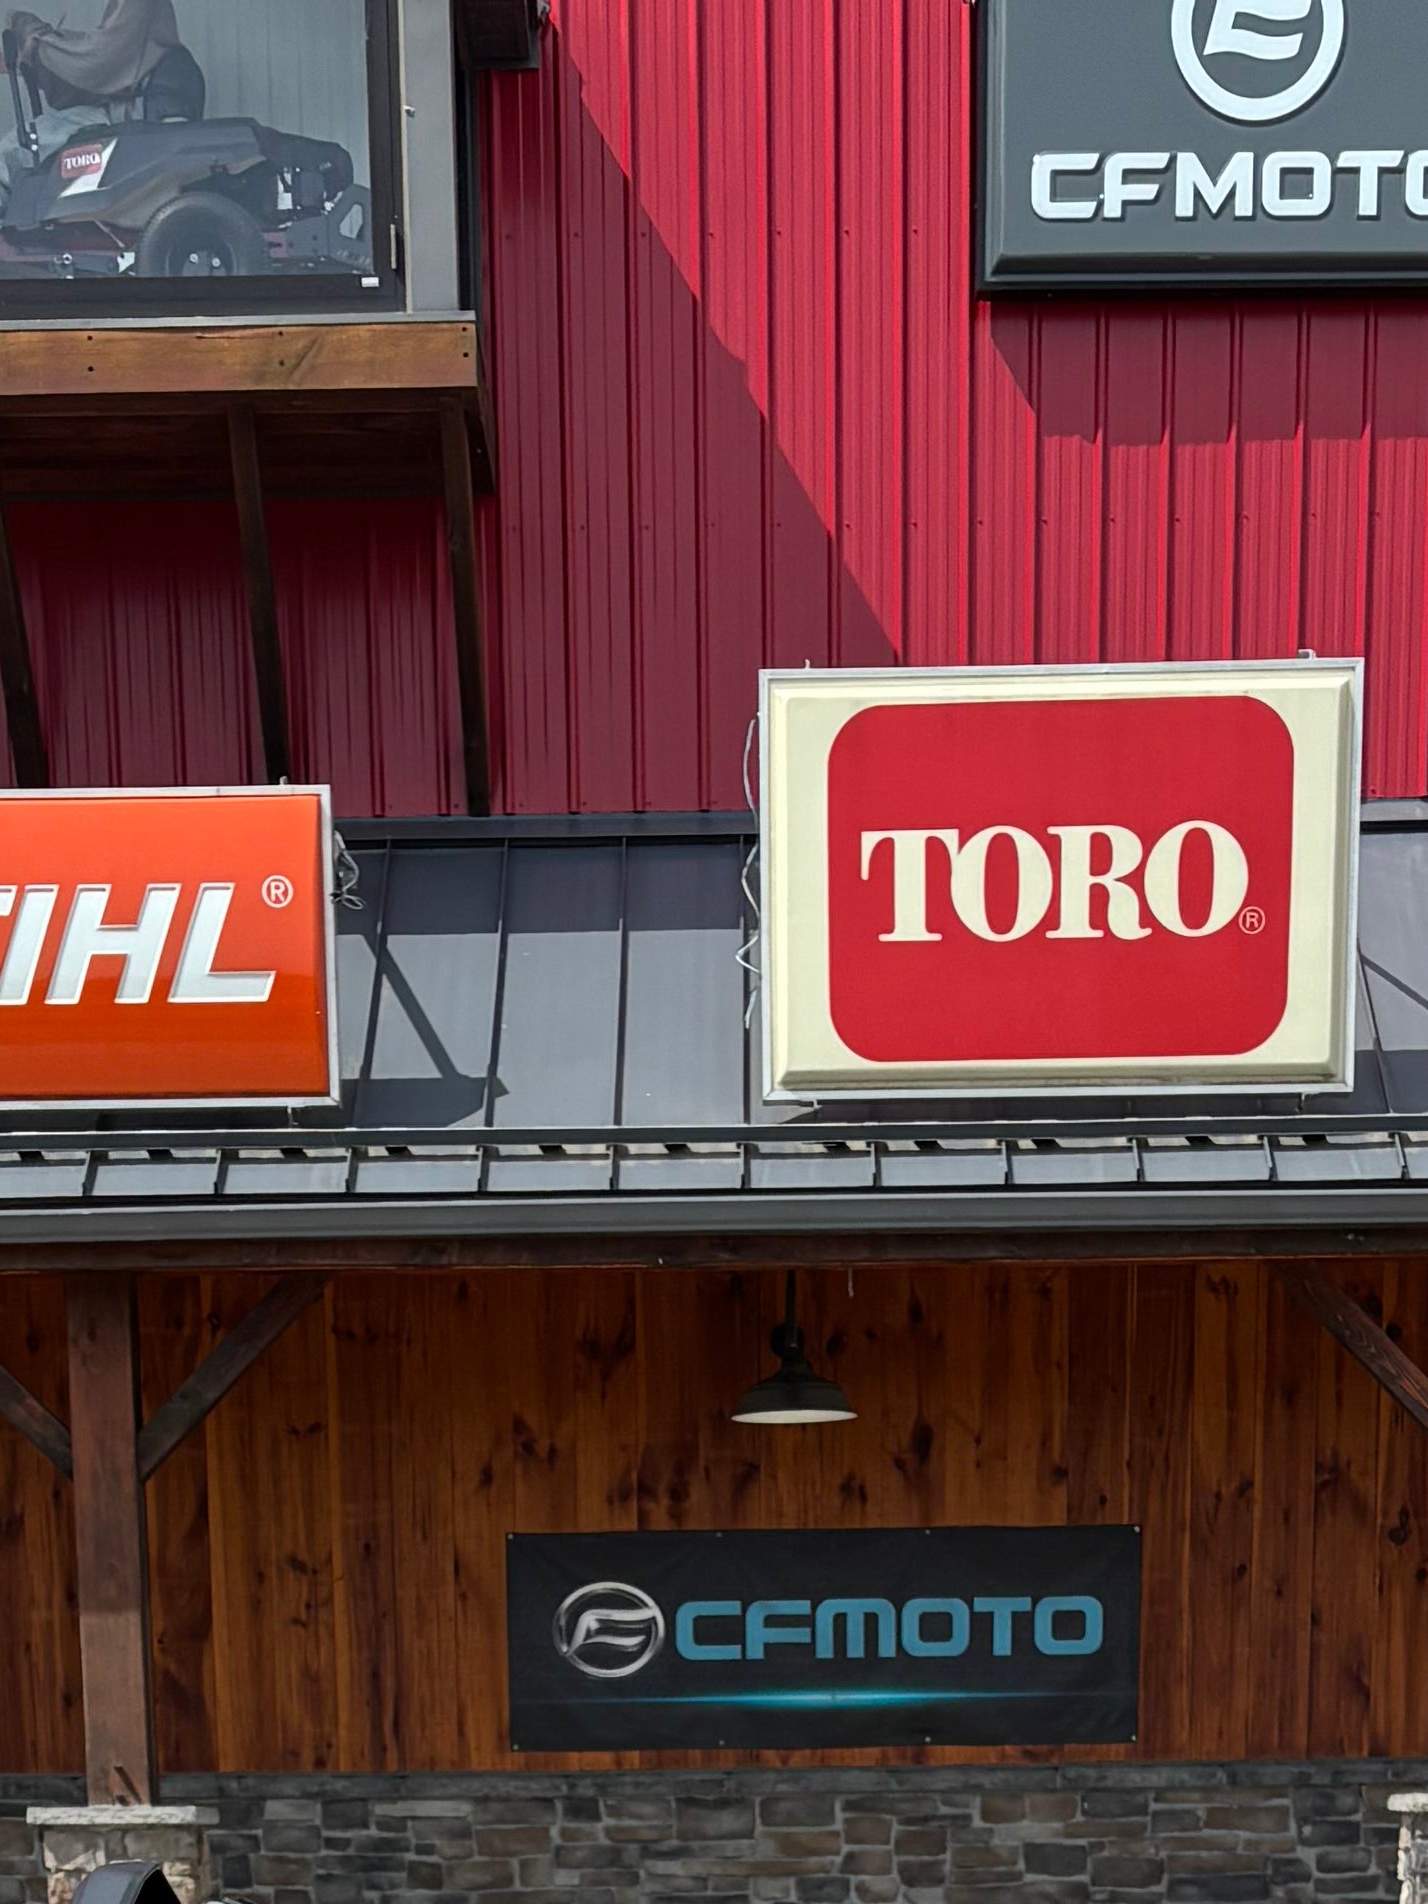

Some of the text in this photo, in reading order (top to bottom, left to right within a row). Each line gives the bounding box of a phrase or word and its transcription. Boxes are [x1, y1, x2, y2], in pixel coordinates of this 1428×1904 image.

[62, 151, 101, 172] TORO
[860, 820, 1250, 942] TORO
[675, 1596, 1104, 1661] CFMOTO
